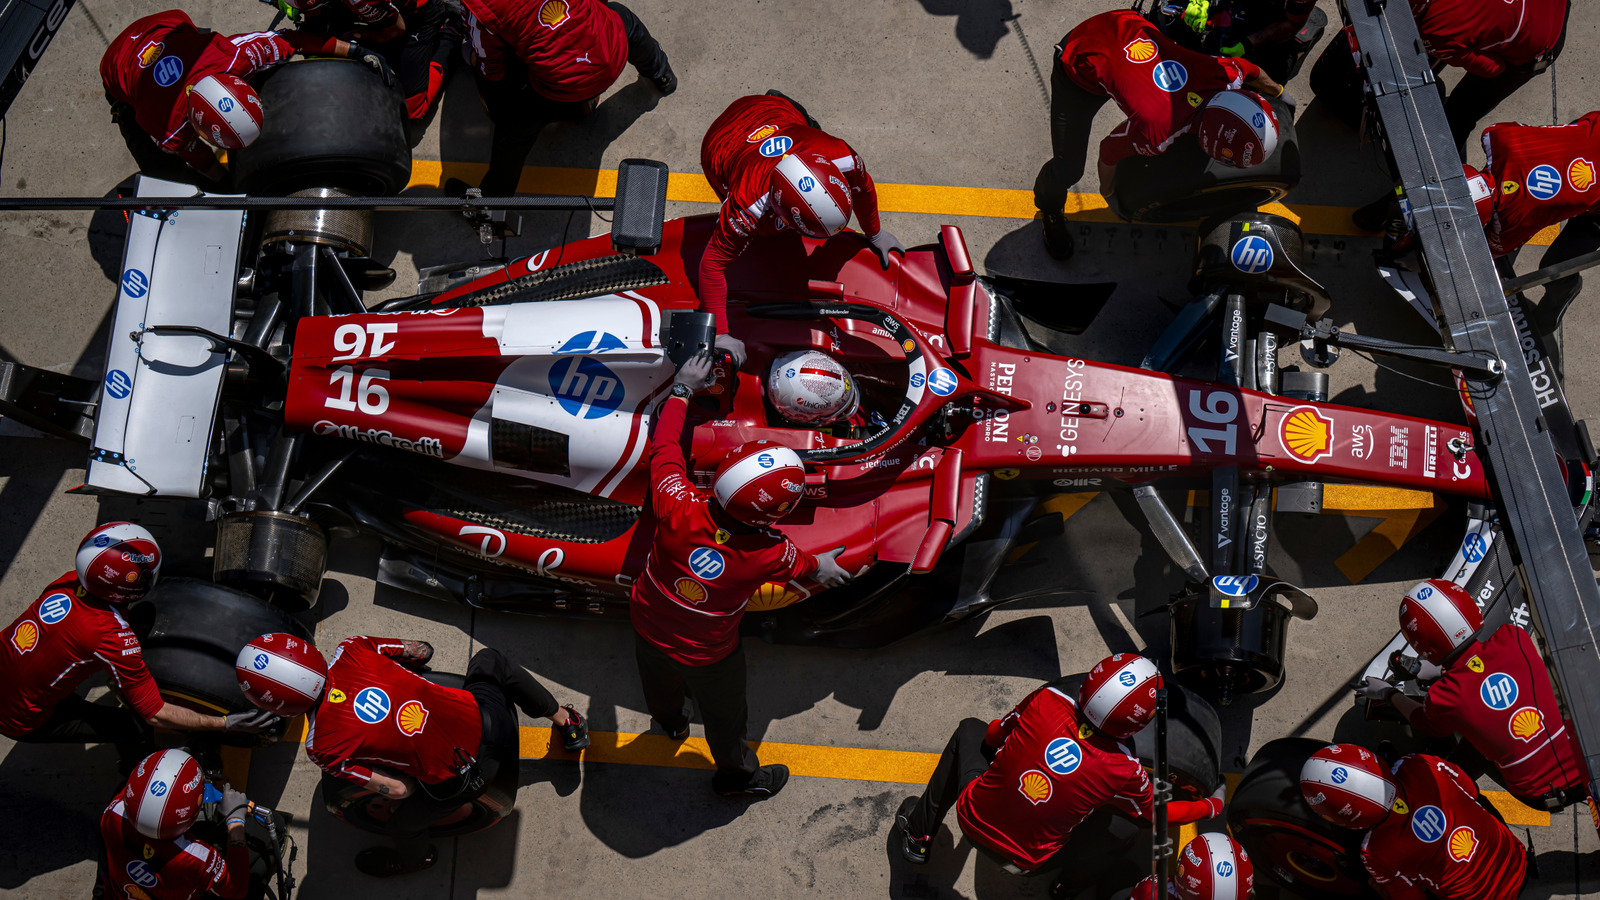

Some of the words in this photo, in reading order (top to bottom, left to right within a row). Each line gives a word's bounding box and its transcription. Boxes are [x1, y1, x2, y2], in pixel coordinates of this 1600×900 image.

[153, 55, 184, 87] hp
[1152, 60, 1188, 92] hp
[759, 136, 793, 157] hp
[1526, 164, 1562, 199] hp
[1231, 235, 1274, 273] hp
[122, 268, 149, 298] hp
[331, 322, 399, 362] 16
[1230, 309, 1243, 349] vantage
[1265, 332, 1278, 375] ESPACI
[105, 369, 132, 399] hp
[324, 365, 391, 416] 16
[548, 356, 625, 420] hp
[910, 373, 925, 388] hp
[928, 367, 958, 396] hp
[893, 404, 910, 425] IBM
[1060, 359, 1085, 441] GENESYS
[864, 426, 890, 443] RICHARD
[1188, 389, 1239, 455] 16
[340, 424, 444, 458] UniCredit
[1352, 425, 1365, 458] aws
[1389, 425, 1409, 469] IBM
[1423, 425, 1437, 478] PIRELLI
[1129, 465, 1177, 473] MILLE
[1220, 488, 1232, 532] vantage
[1253, 515, 1267, 569] ESPACIO
[1462, 532, 1487, 563] hp
[688, 546, 725, 579] hp
[39, 593, 72, 625] hp
[1417, 587, 1433, 600] hp
[253, 653, 269, 670] hp
[1119, 671, 1136, 687] hp
[1480, 672, 1519, 710] hp
[354, 687, 391, 724] hp
[1044, 737, 1082, 775] hp
[150, 780, 167, 797] hp
[1331, 767, 1349, 784] hp
[1411, 805, 1447, 843] hp
[126, 860, 158, 888] hp
[1216, 861, 1233, 878] hp
